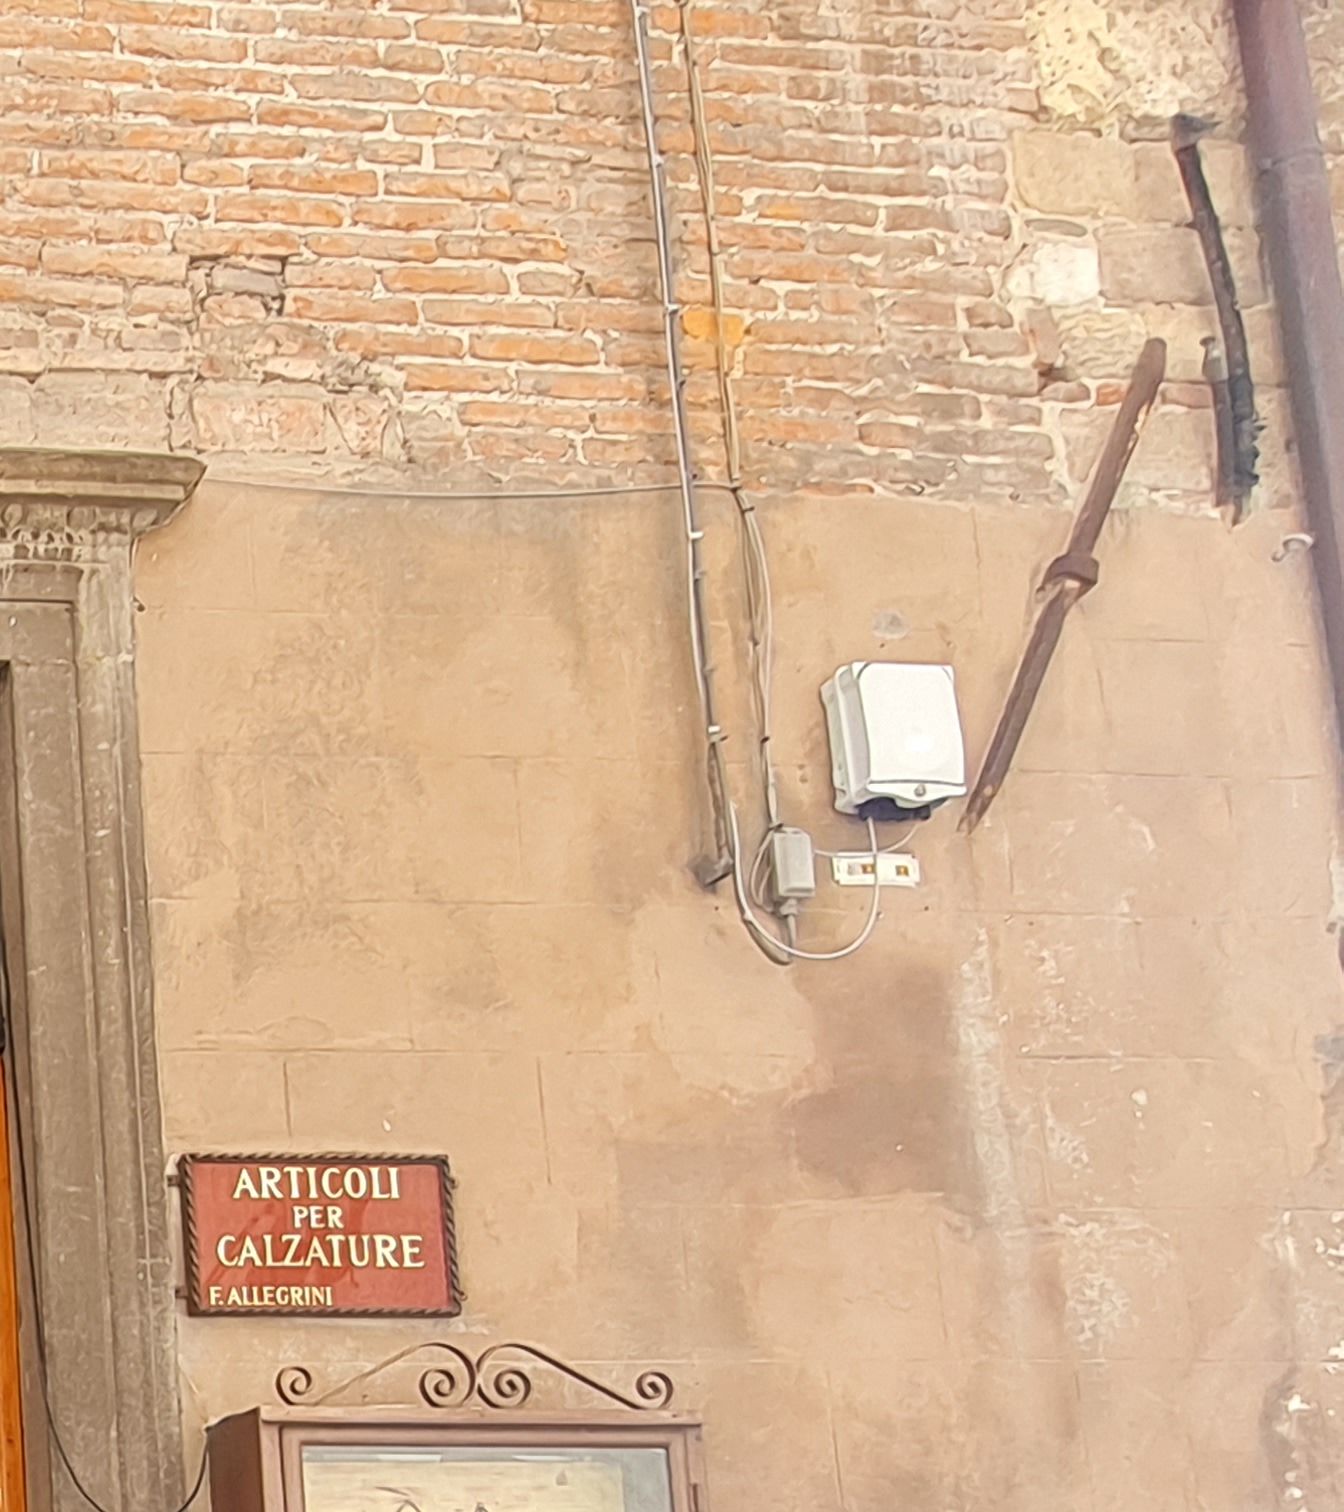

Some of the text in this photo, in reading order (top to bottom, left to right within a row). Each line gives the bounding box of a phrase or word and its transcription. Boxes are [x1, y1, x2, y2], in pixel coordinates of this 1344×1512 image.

[233, 1166, 400, 1199] ARTICOLI
[293, 1205, 344, 1229] PER
[217, 1234, 426, 1267] CALZATURE
